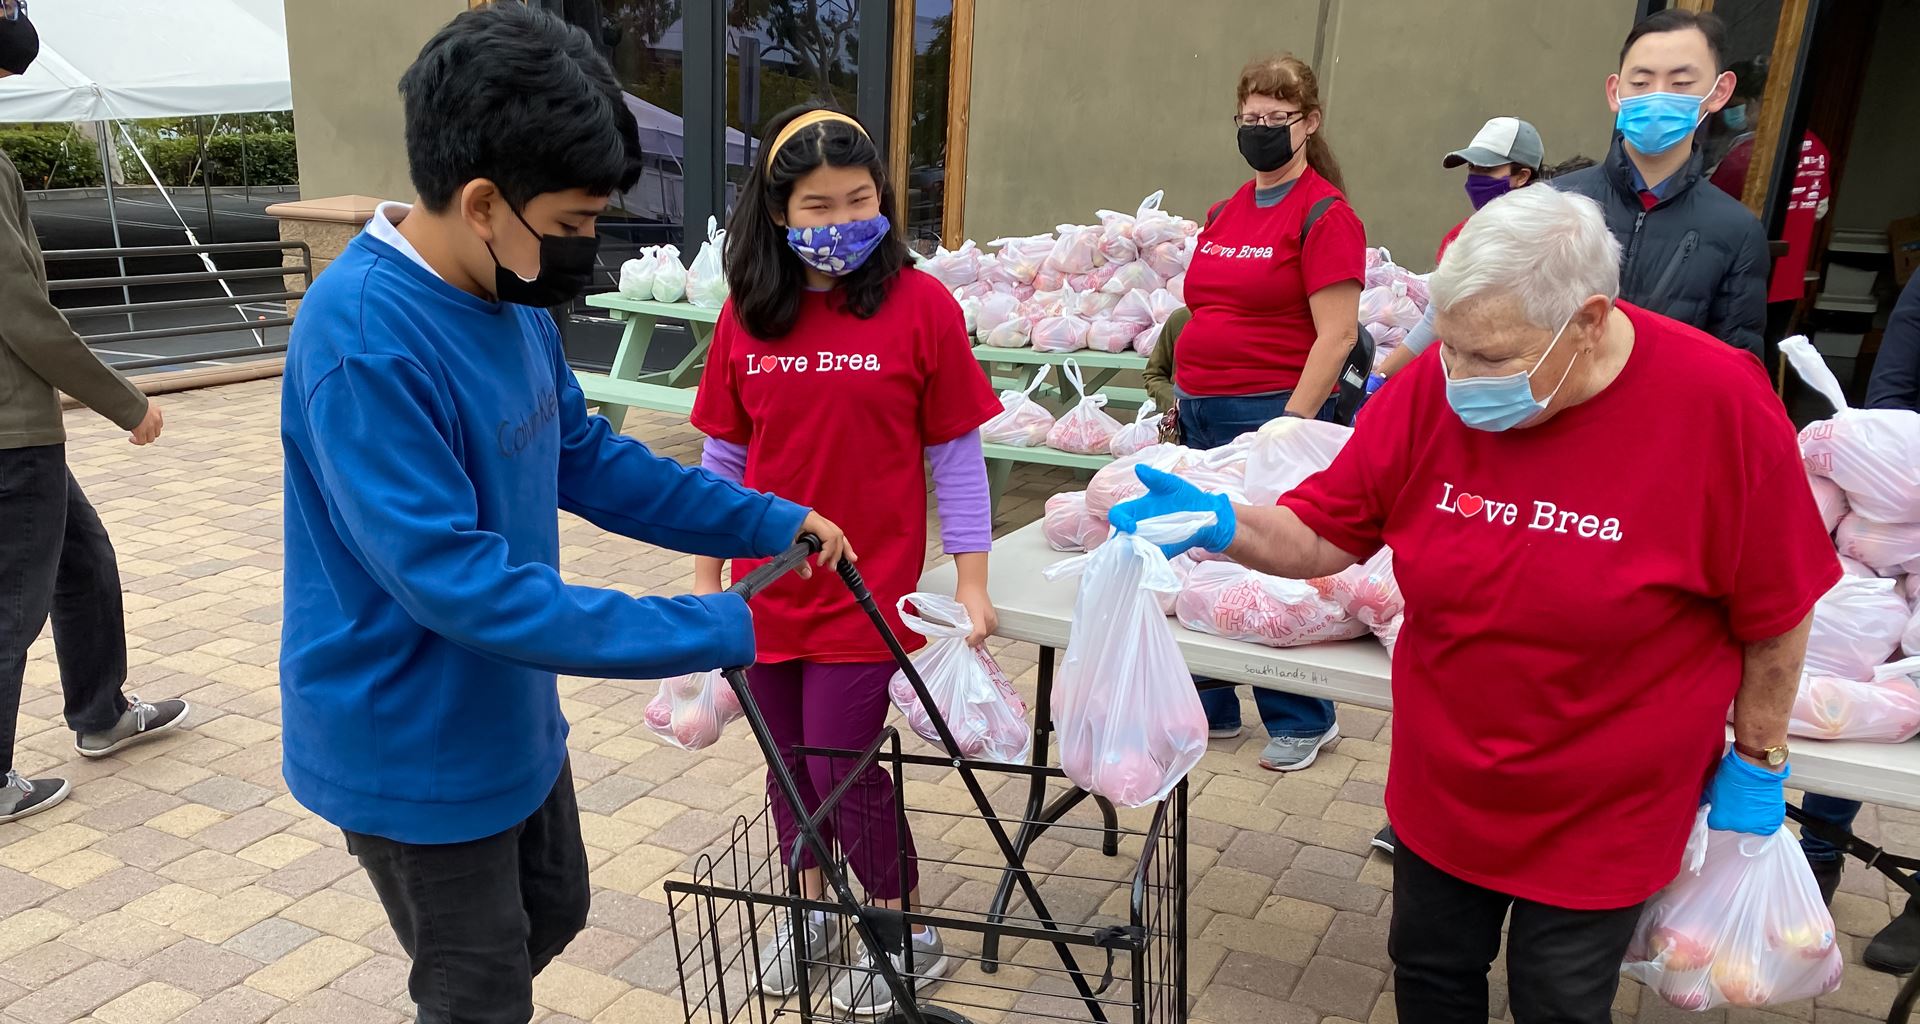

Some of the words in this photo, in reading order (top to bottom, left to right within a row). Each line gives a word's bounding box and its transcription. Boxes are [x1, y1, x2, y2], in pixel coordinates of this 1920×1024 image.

[1236, 245, 1273, 258] Brea
[815, 351, 881, 372] Brea
[1528, 500, 1623, 541] Brea
[1244, 663, 1306, 680] Southlands
